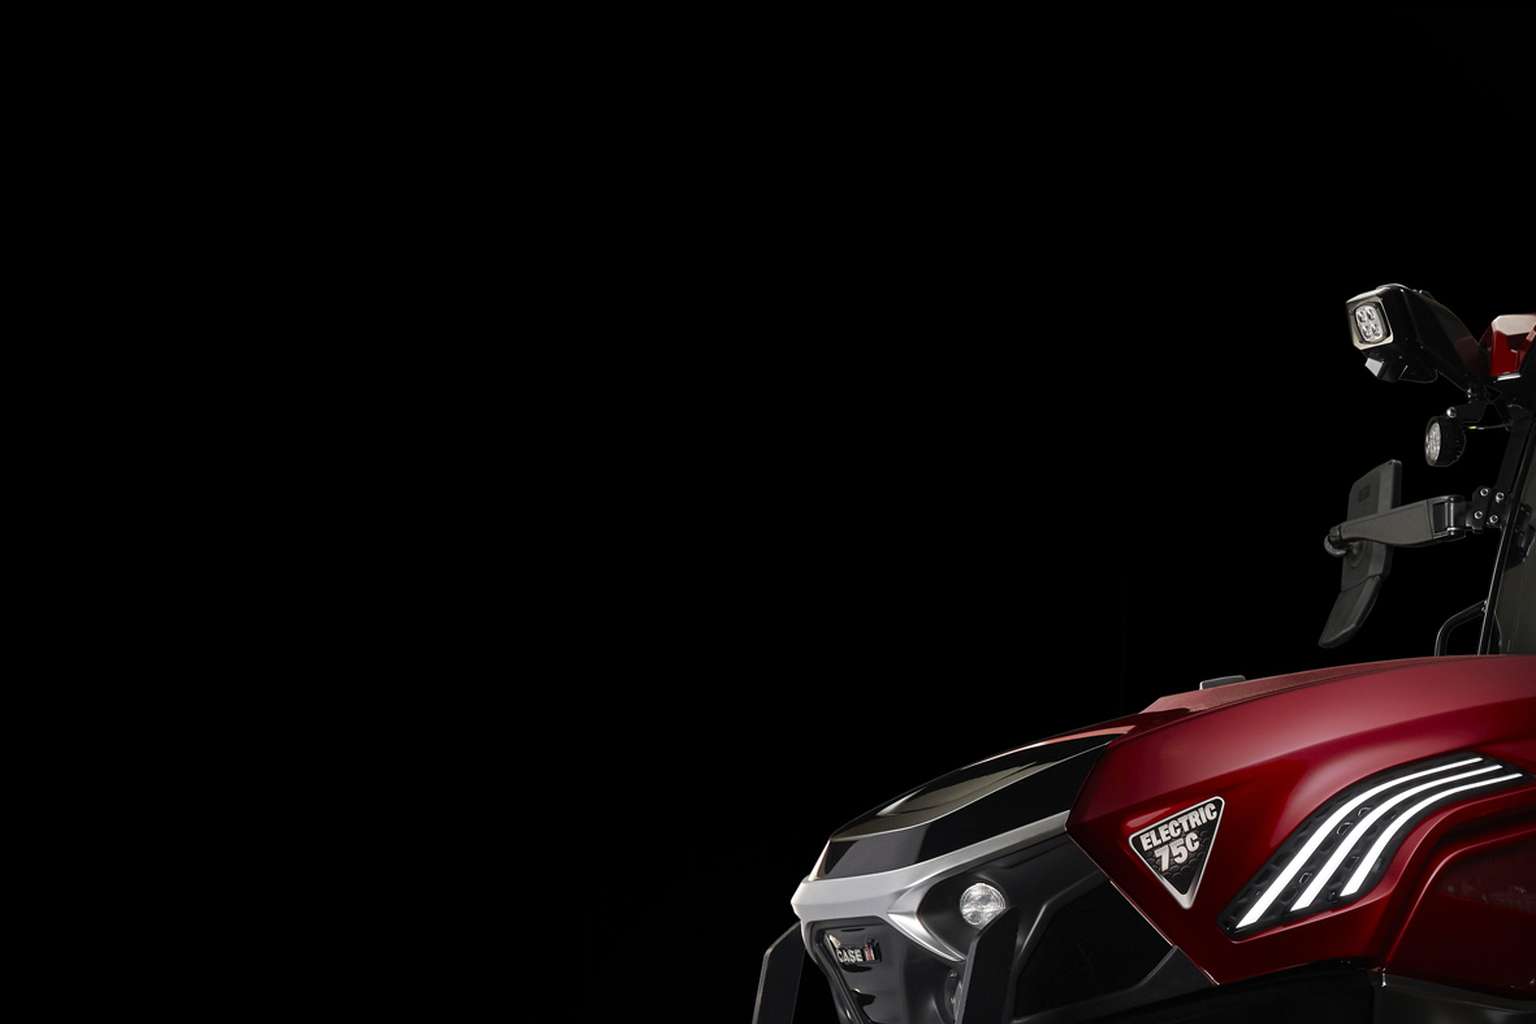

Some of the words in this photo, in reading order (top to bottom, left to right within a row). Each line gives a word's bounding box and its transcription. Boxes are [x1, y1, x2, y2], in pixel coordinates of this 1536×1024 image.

[1139, 802, 1218, 851] ELECTRIC
[1154, 831, 1200, 872] 75C
[836, 948, 863, 963] CASE
